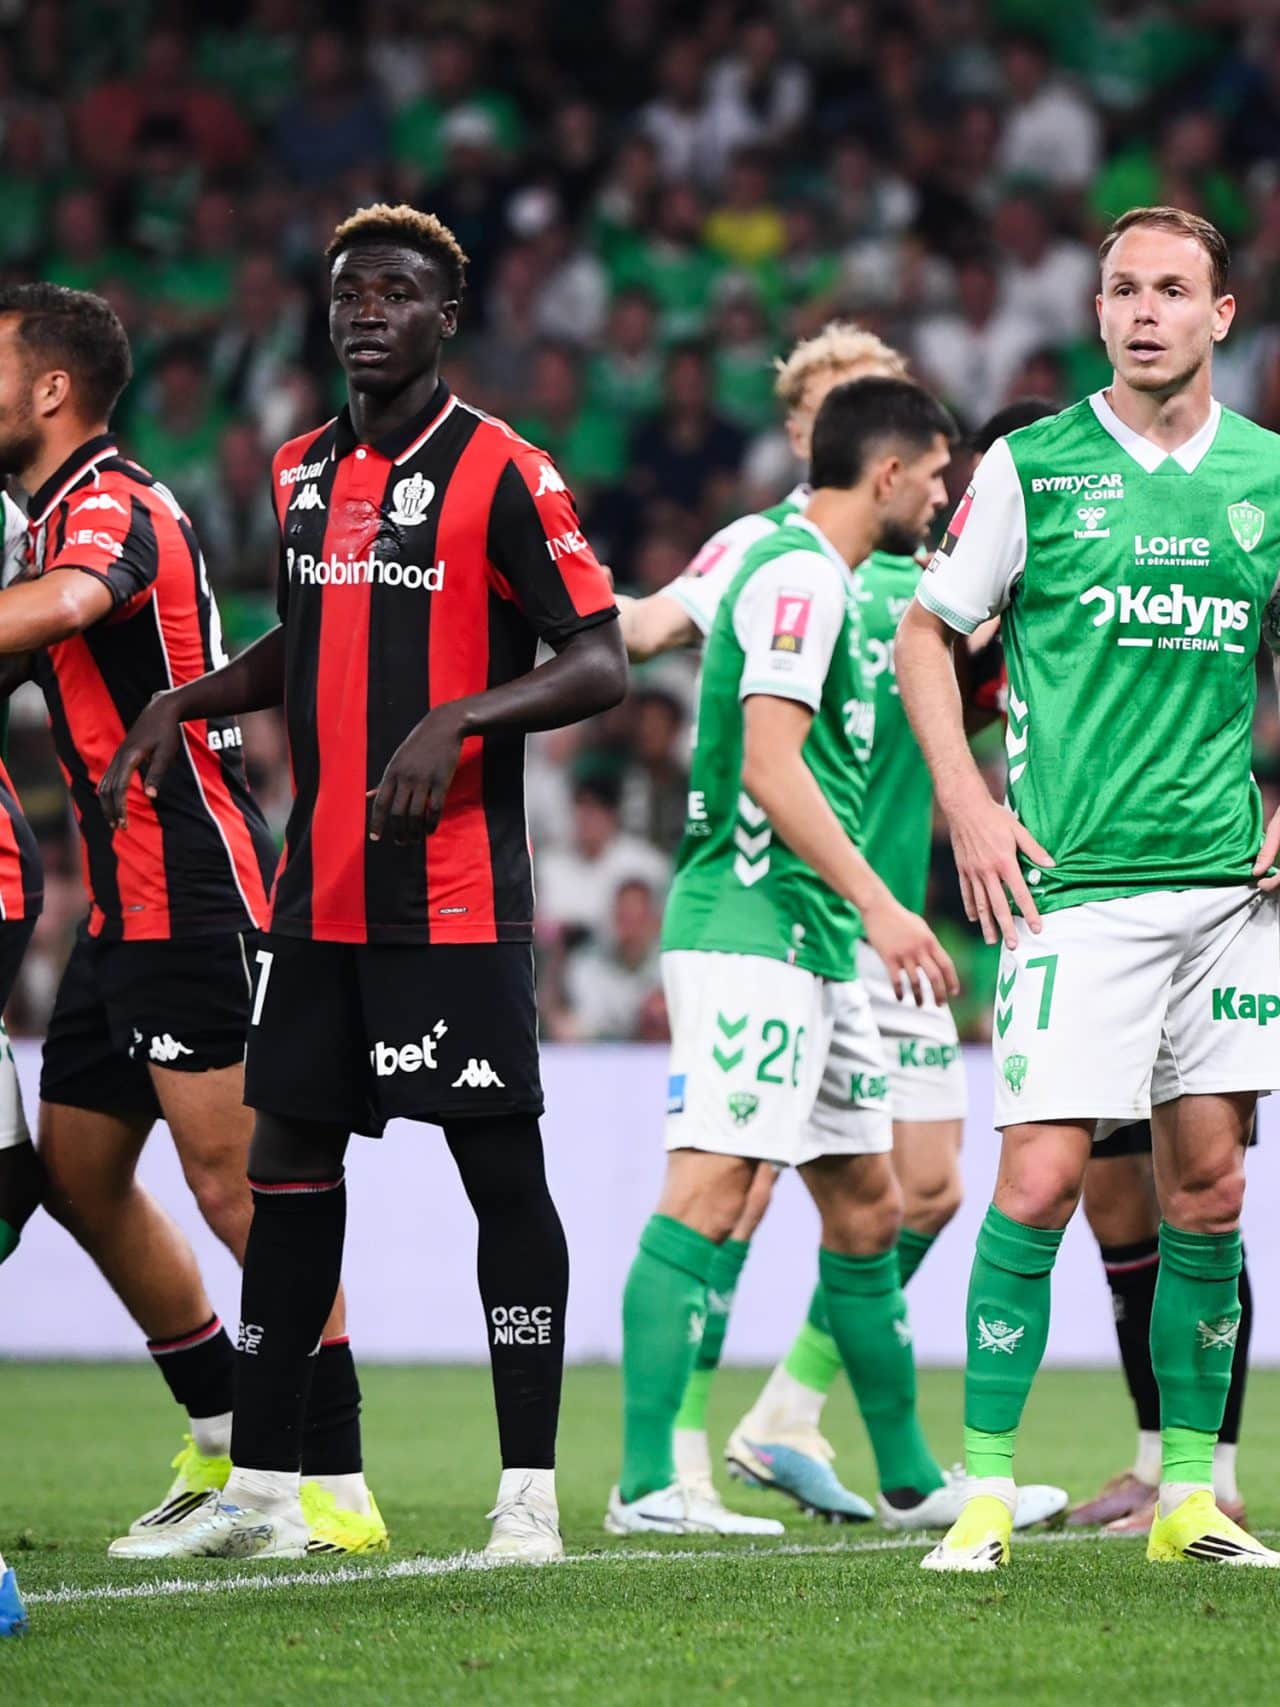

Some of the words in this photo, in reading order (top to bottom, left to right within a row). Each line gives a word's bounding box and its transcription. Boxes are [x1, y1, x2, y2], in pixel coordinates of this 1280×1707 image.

[280, 457, 328, 486] actual
[1084, 489, 1124, 500] LOIRE
[1134, 534, 1210, 556] Loire
[300, 551, 446, 592] Robinhood
[1135, 557, 1145, 566] LE
[1116, 583, 1251, 638] Kelyps
[1157, 637, 1219, 652] INTERIM
[1026, 954, 1059, 1031] 7
[369, 1034, 438, 1077] bet
[491, 1305, 553, 1326] OGC
[493, 1325, 552, 1345] NICE
